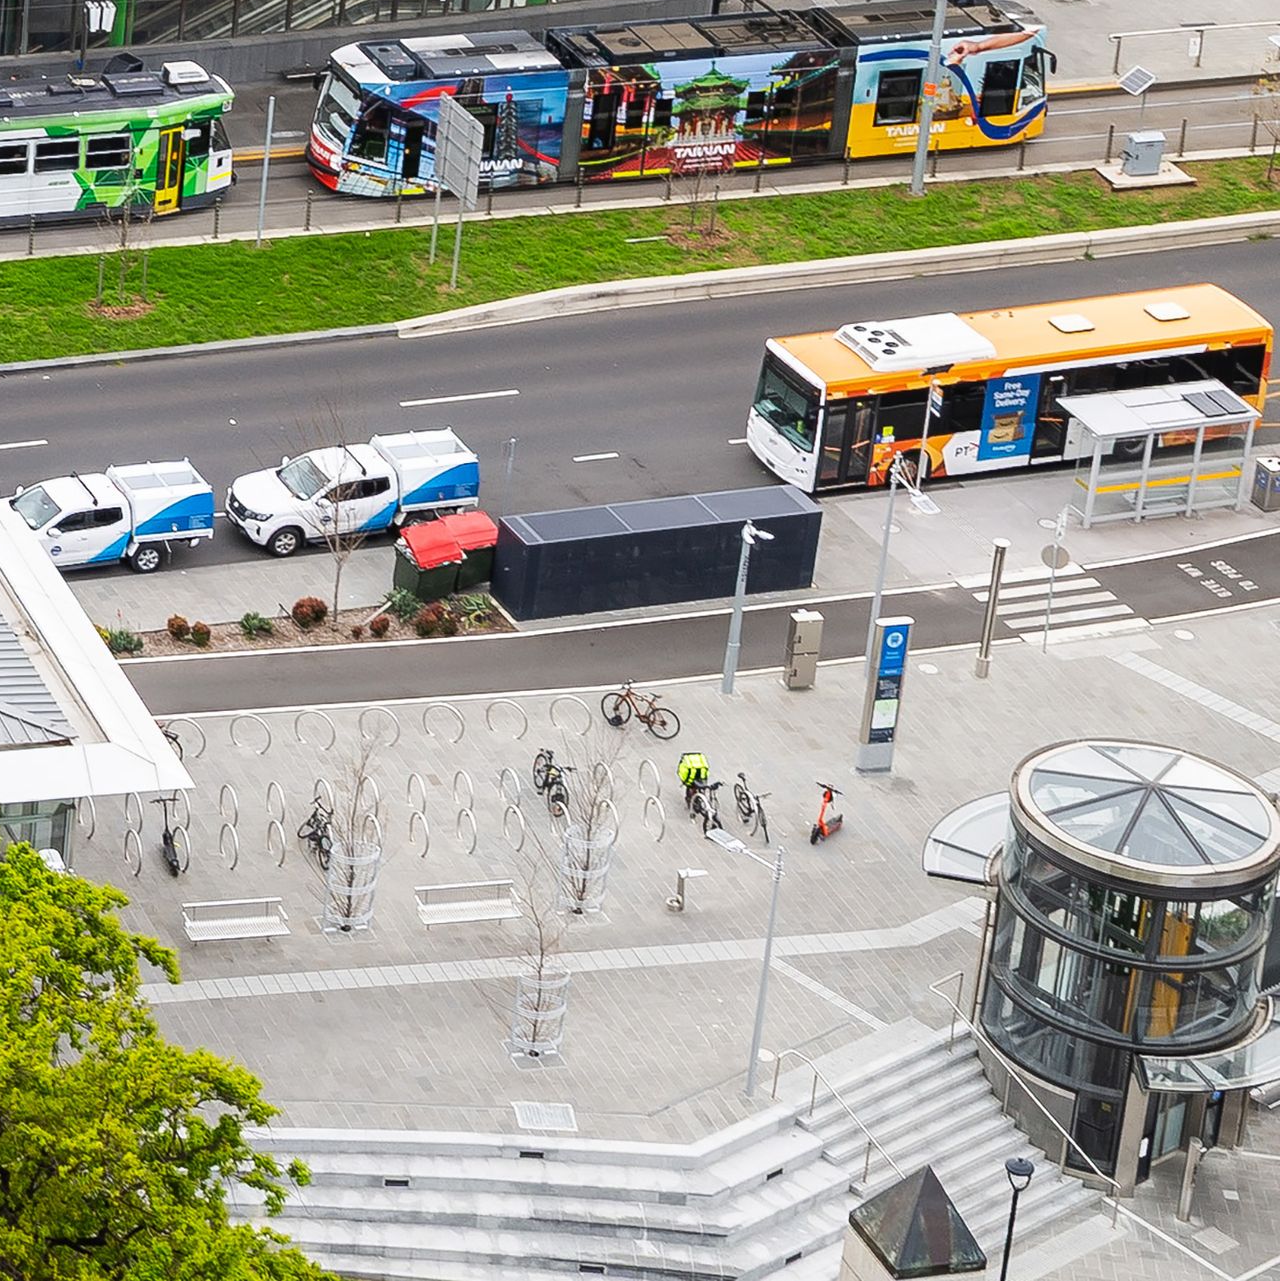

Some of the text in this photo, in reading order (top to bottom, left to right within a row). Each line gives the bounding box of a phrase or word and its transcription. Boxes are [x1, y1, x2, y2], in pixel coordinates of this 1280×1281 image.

[674, 143, 736, 159] TAIWAN
[479, 158, 524, 172] IWAN
[1004, 382, 1023, 391] Free
